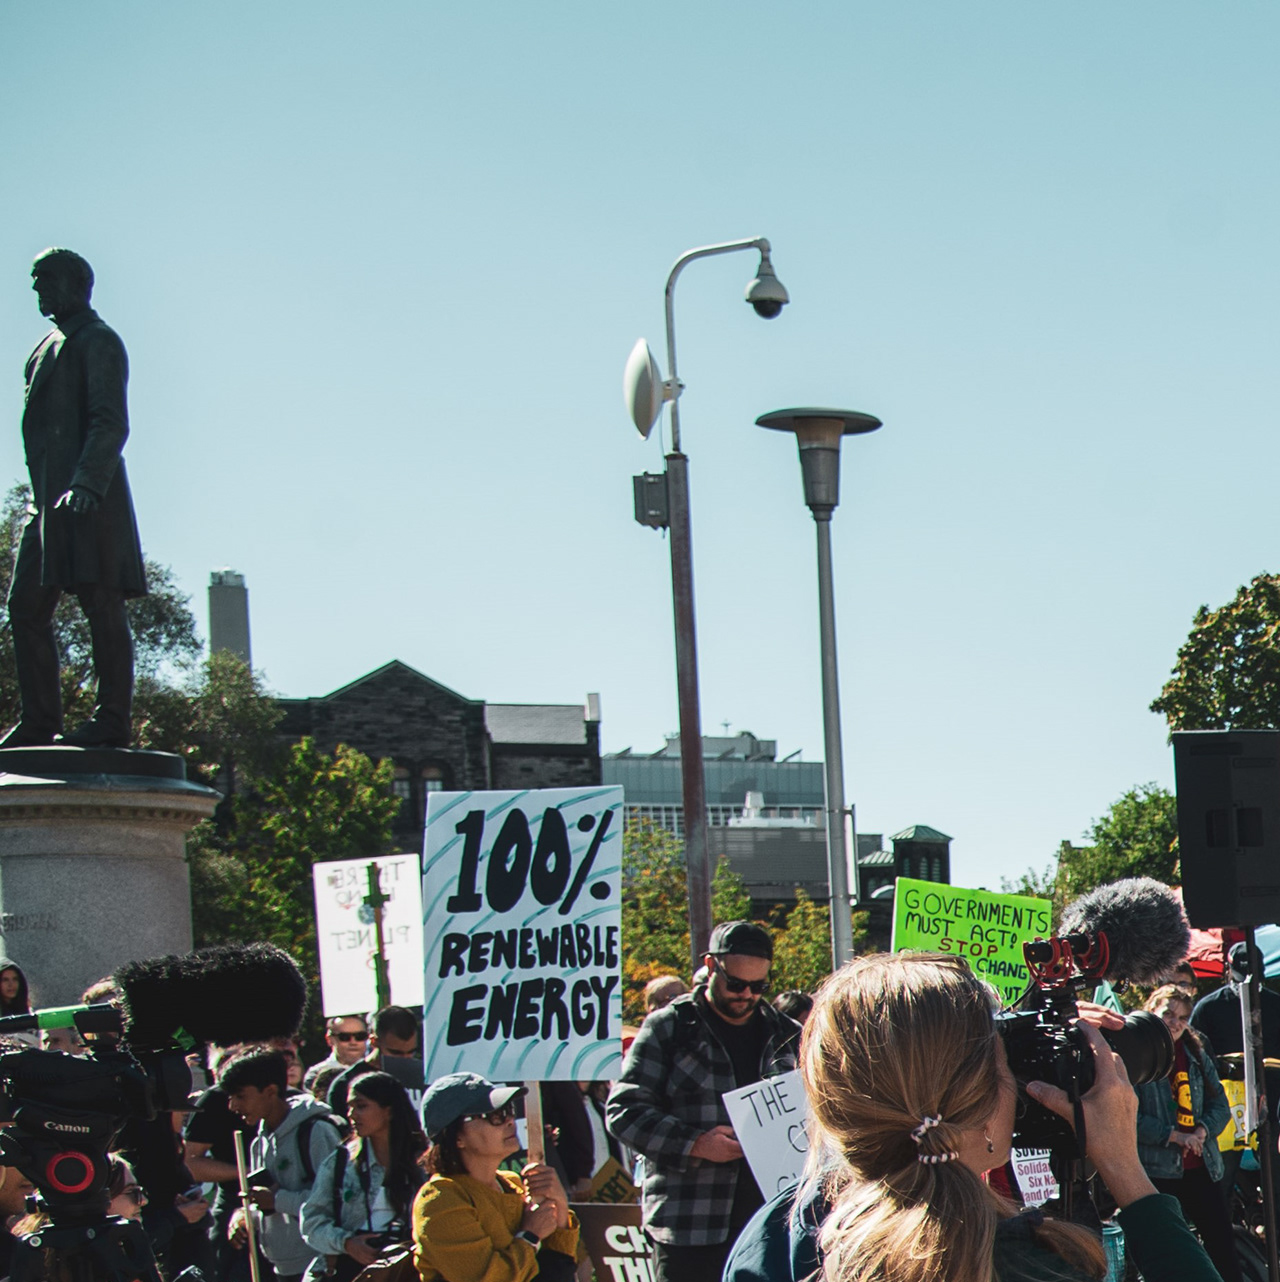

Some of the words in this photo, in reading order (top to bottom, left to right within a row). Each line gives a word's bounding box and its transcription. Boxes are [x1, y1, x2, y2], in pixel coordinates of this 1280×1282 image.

[446, 806, 614, 915] 100%
[905, 889, 1049, 933] GOVERNMENTS
[905, 912, 955, 937] MUST
[438, 923, 618, 978] RENEWABLE
[938, 938, 998, 957] STOP
[446, 975, 619, 1046] ENERGY
[741, 1081, 797, 1128] THE
[44, 1121, 90, 1133] Canon
[1028, 1174, 1043, 1188] Six
